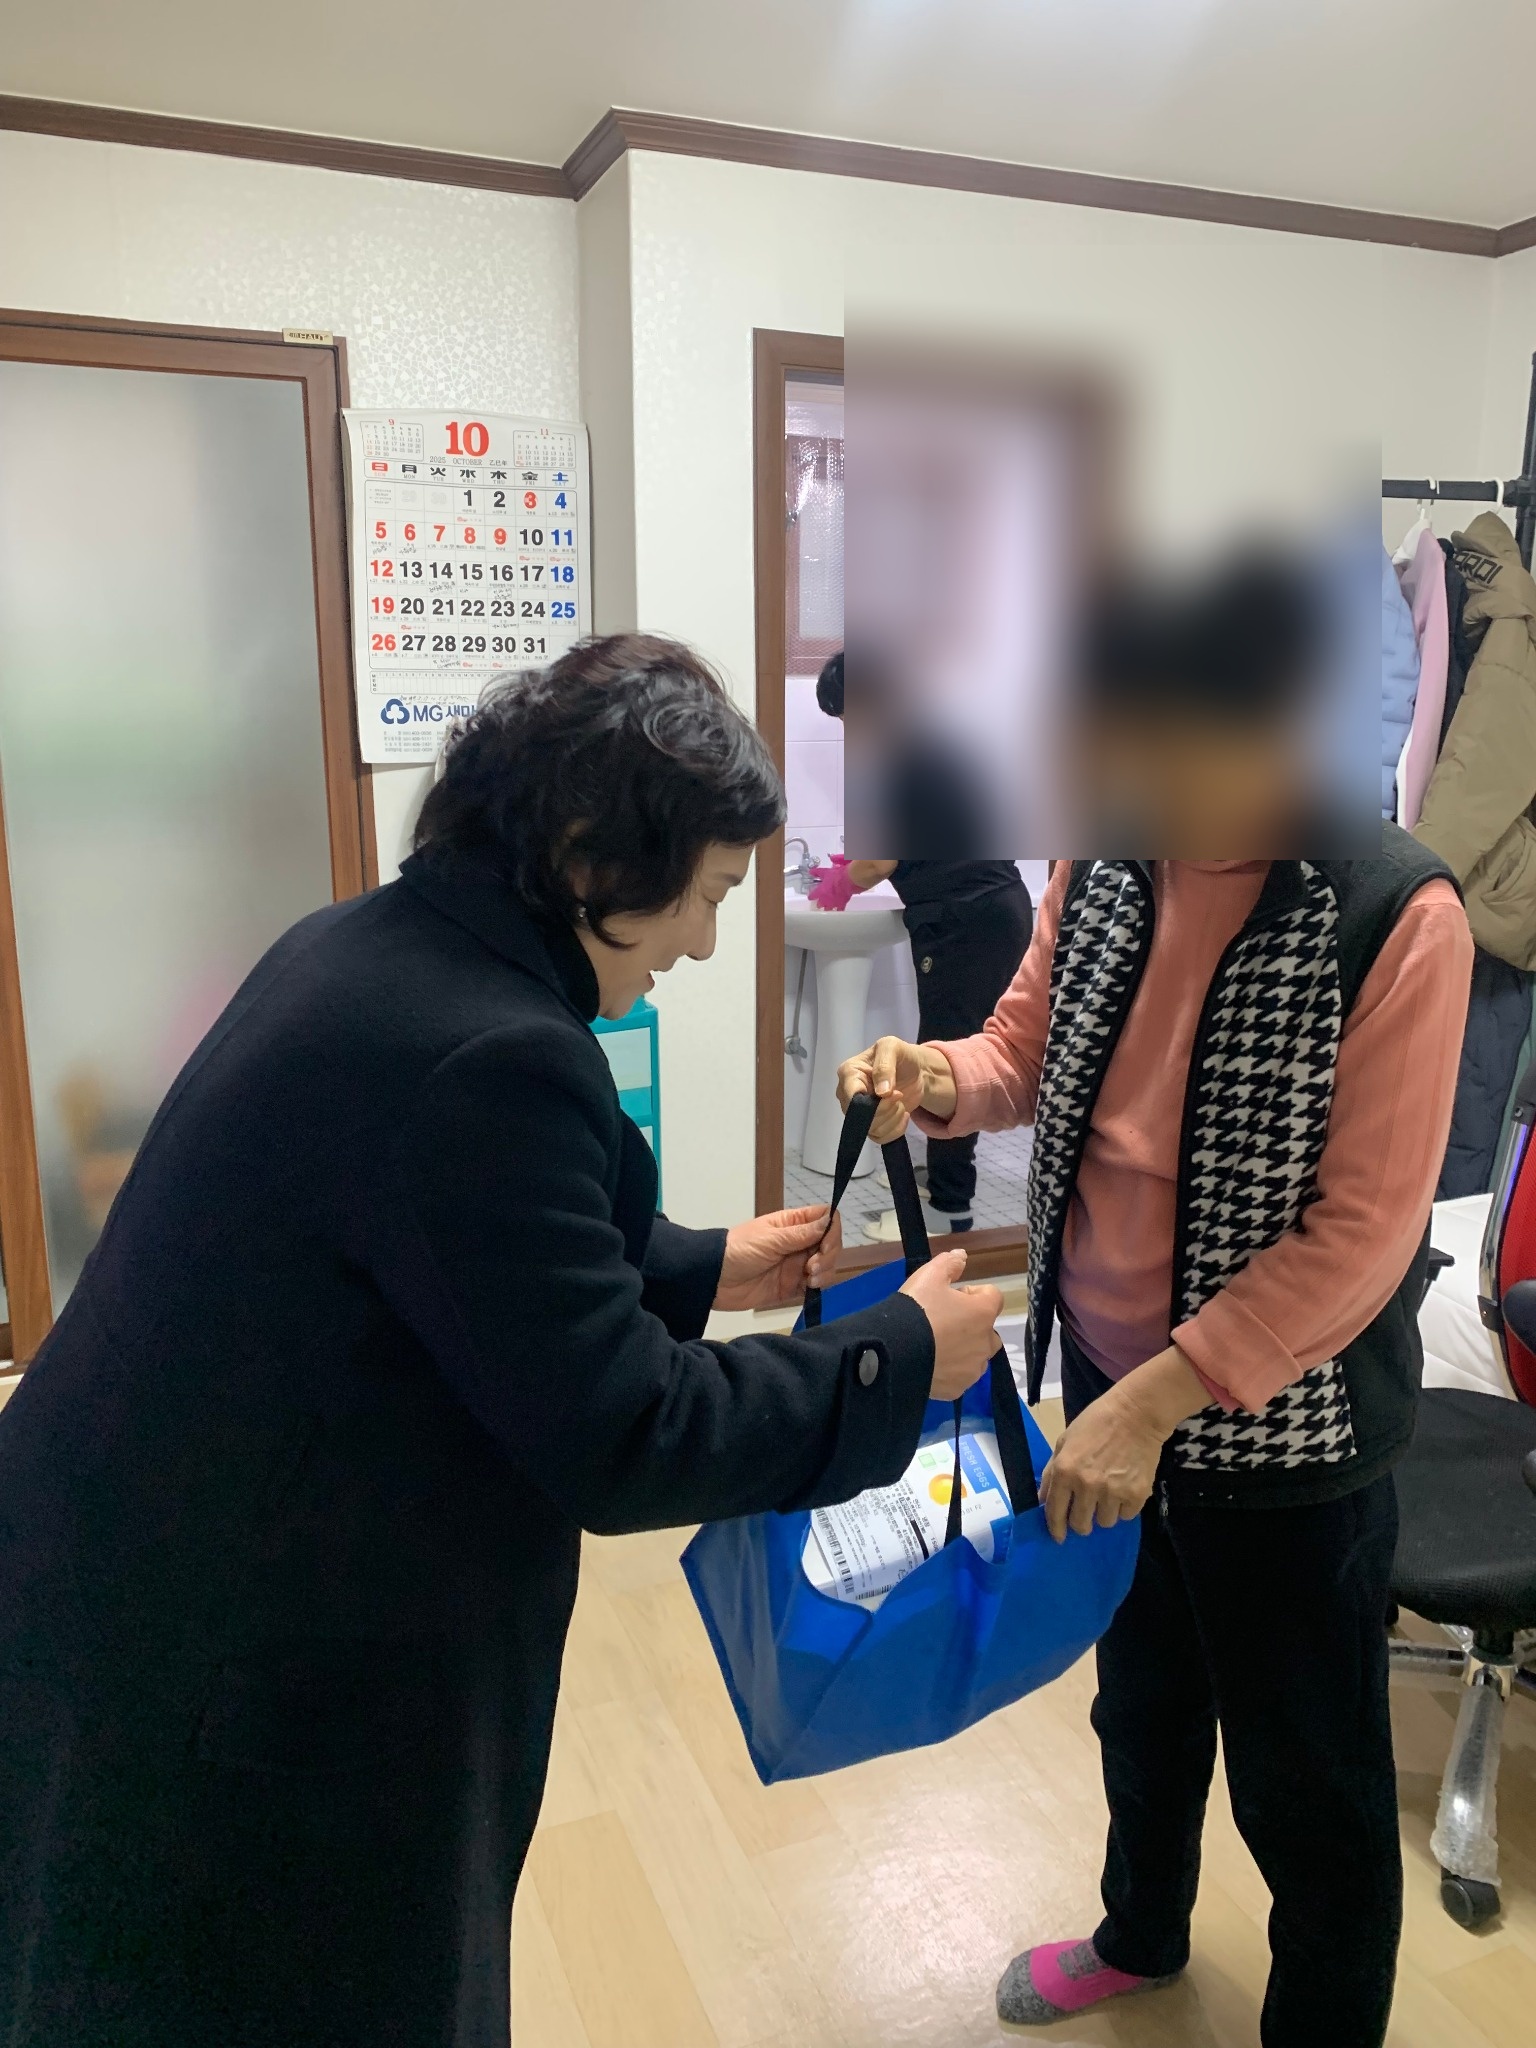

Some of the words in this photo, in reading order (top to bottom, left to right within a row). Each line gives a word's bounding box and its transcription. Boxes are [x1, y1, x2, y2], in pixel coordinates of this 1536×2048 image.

[446, 421, 489, 457] 10
[372, 462, 388, 471] 日
[402, 464, 417, 473] 月
[452, 458, 483, 466] OCTOBER
[430, 467, 446, 476] 火
[460, 469, 476, 478] 水
[490, 471, 507, 480] 木
[522, 471, 538, 480] 金
[552, 472, 569, 481] 土
[464, 490, 473, 506] 1
[494, 491, 506, 507] 2
[524, 491, 537, 509] 3
[555, 492, 567, 509] 4
[375, 522, 387, 539] 5
[404, 523, 416, 541] 6
[433, 525, 446, 542] 7
[463, 527, 476, 544] 8
[494, 528, 506, 545] 9
[520, 529, 543, 546] 10
[551, 529, 573, 546] 11
[370, 560, 394, 577] 12
[400, 561, 423, 578] 13
[429, 562, 453, 579] 14
[460, 563, 483, 580] 15
[489, 564, 513, 581] 16
[520, 565, 544, 582] 17
[551, 566, 575, 583] 18
[371, 597, 395, 614] 19
[401, 598, 425, 615] 20
[432, 598, 454, 616] 21
[461, 599, 485, 617] 22
[490, 600, 515, 617] 23
[521, 601, 546, 618] 24
[551, 601, 576, 619] 25
[371, 634, 397, 651] 26
[402, 634, 426, 651] 27
[432, 635, 457, 652] 28
[462, 636, 487, 653] 29
[492, 636, 516, 653] 30
[523, 637, 546, 654] 31
[413, 704, 443, 722] MG
[961, 1441, 978, 1466] FRESH
[974, 1467, 990, 1488] EGGS
